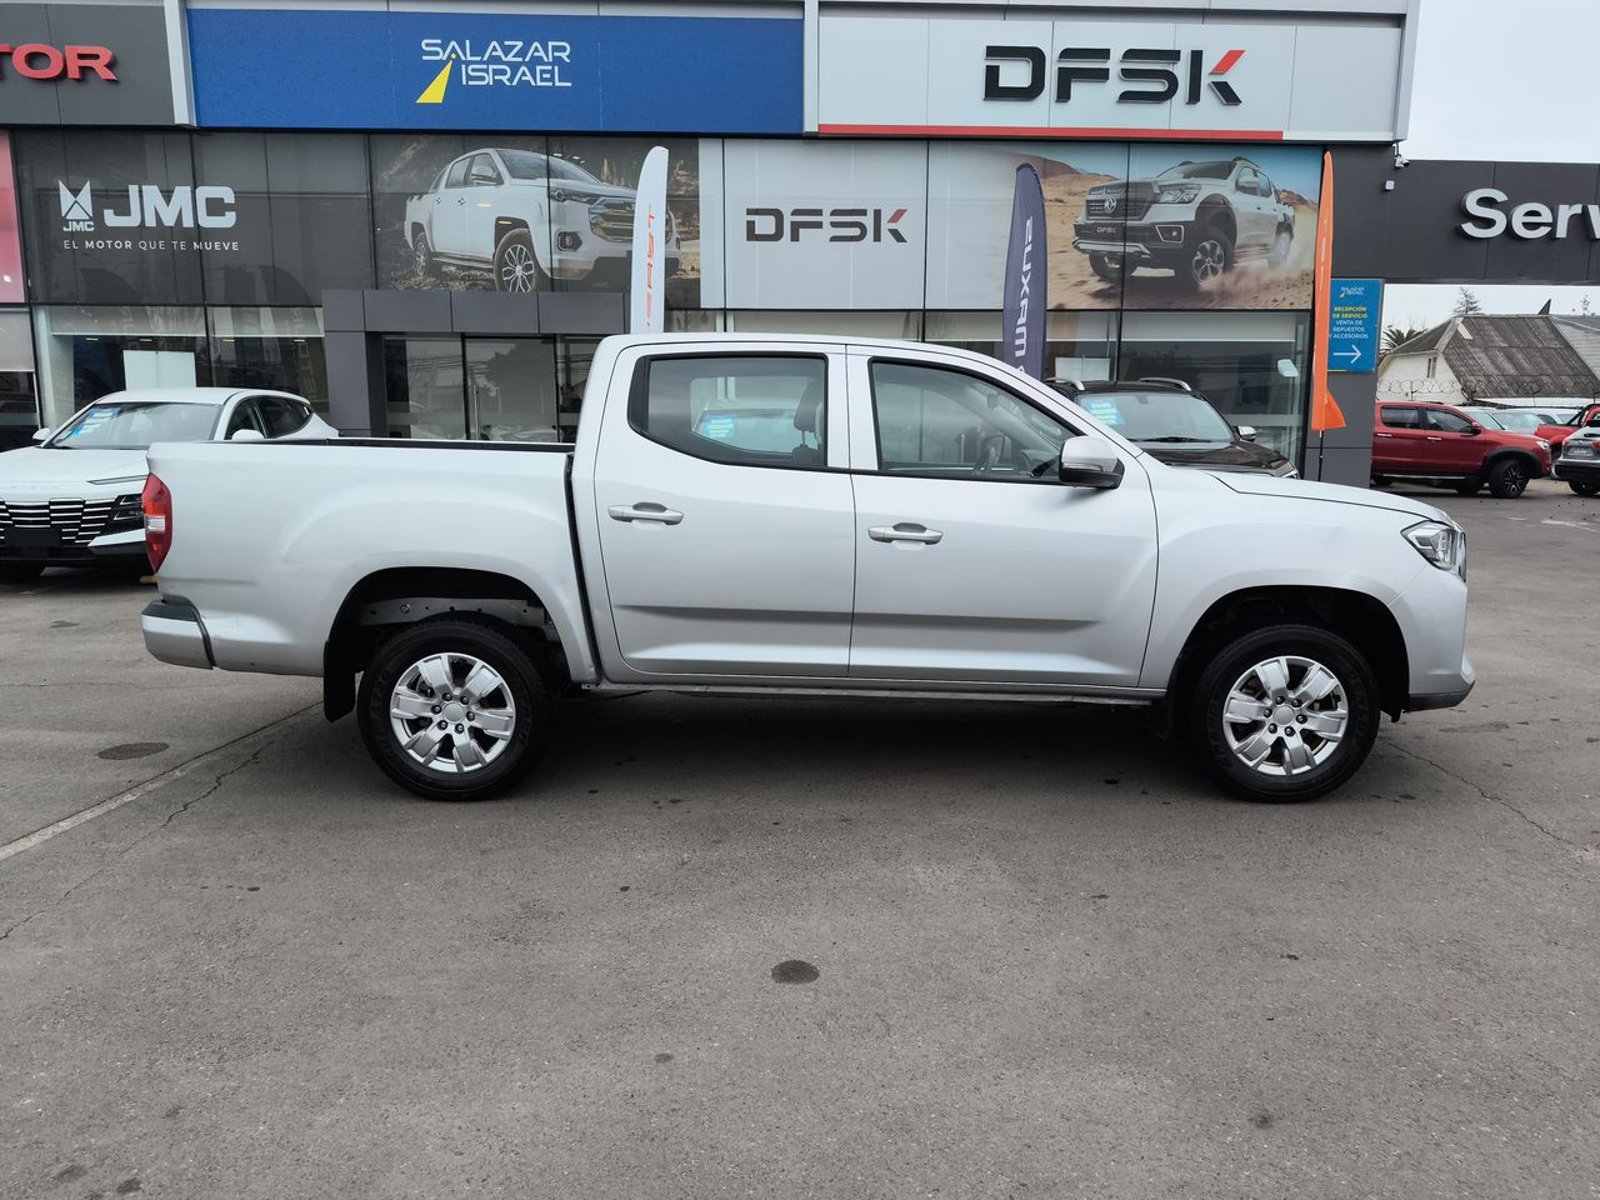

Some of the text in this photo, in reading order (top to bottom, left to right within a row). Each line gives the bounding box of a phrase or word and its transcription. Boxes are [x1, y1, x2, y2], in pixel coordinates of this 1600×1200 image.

[421, 39, 571, 62] SALAZAR
[461, 64, 572, 87] ISRAEL
[984, 45, 1246, 105] DFSK
[103, 184, 237, 228] JMC
[62, 221, 95, 232] JMC
[746, 208, 908, 243] DFSK
[63, 240, 239, 251] EL MOTOR QUE TE MUEVE
